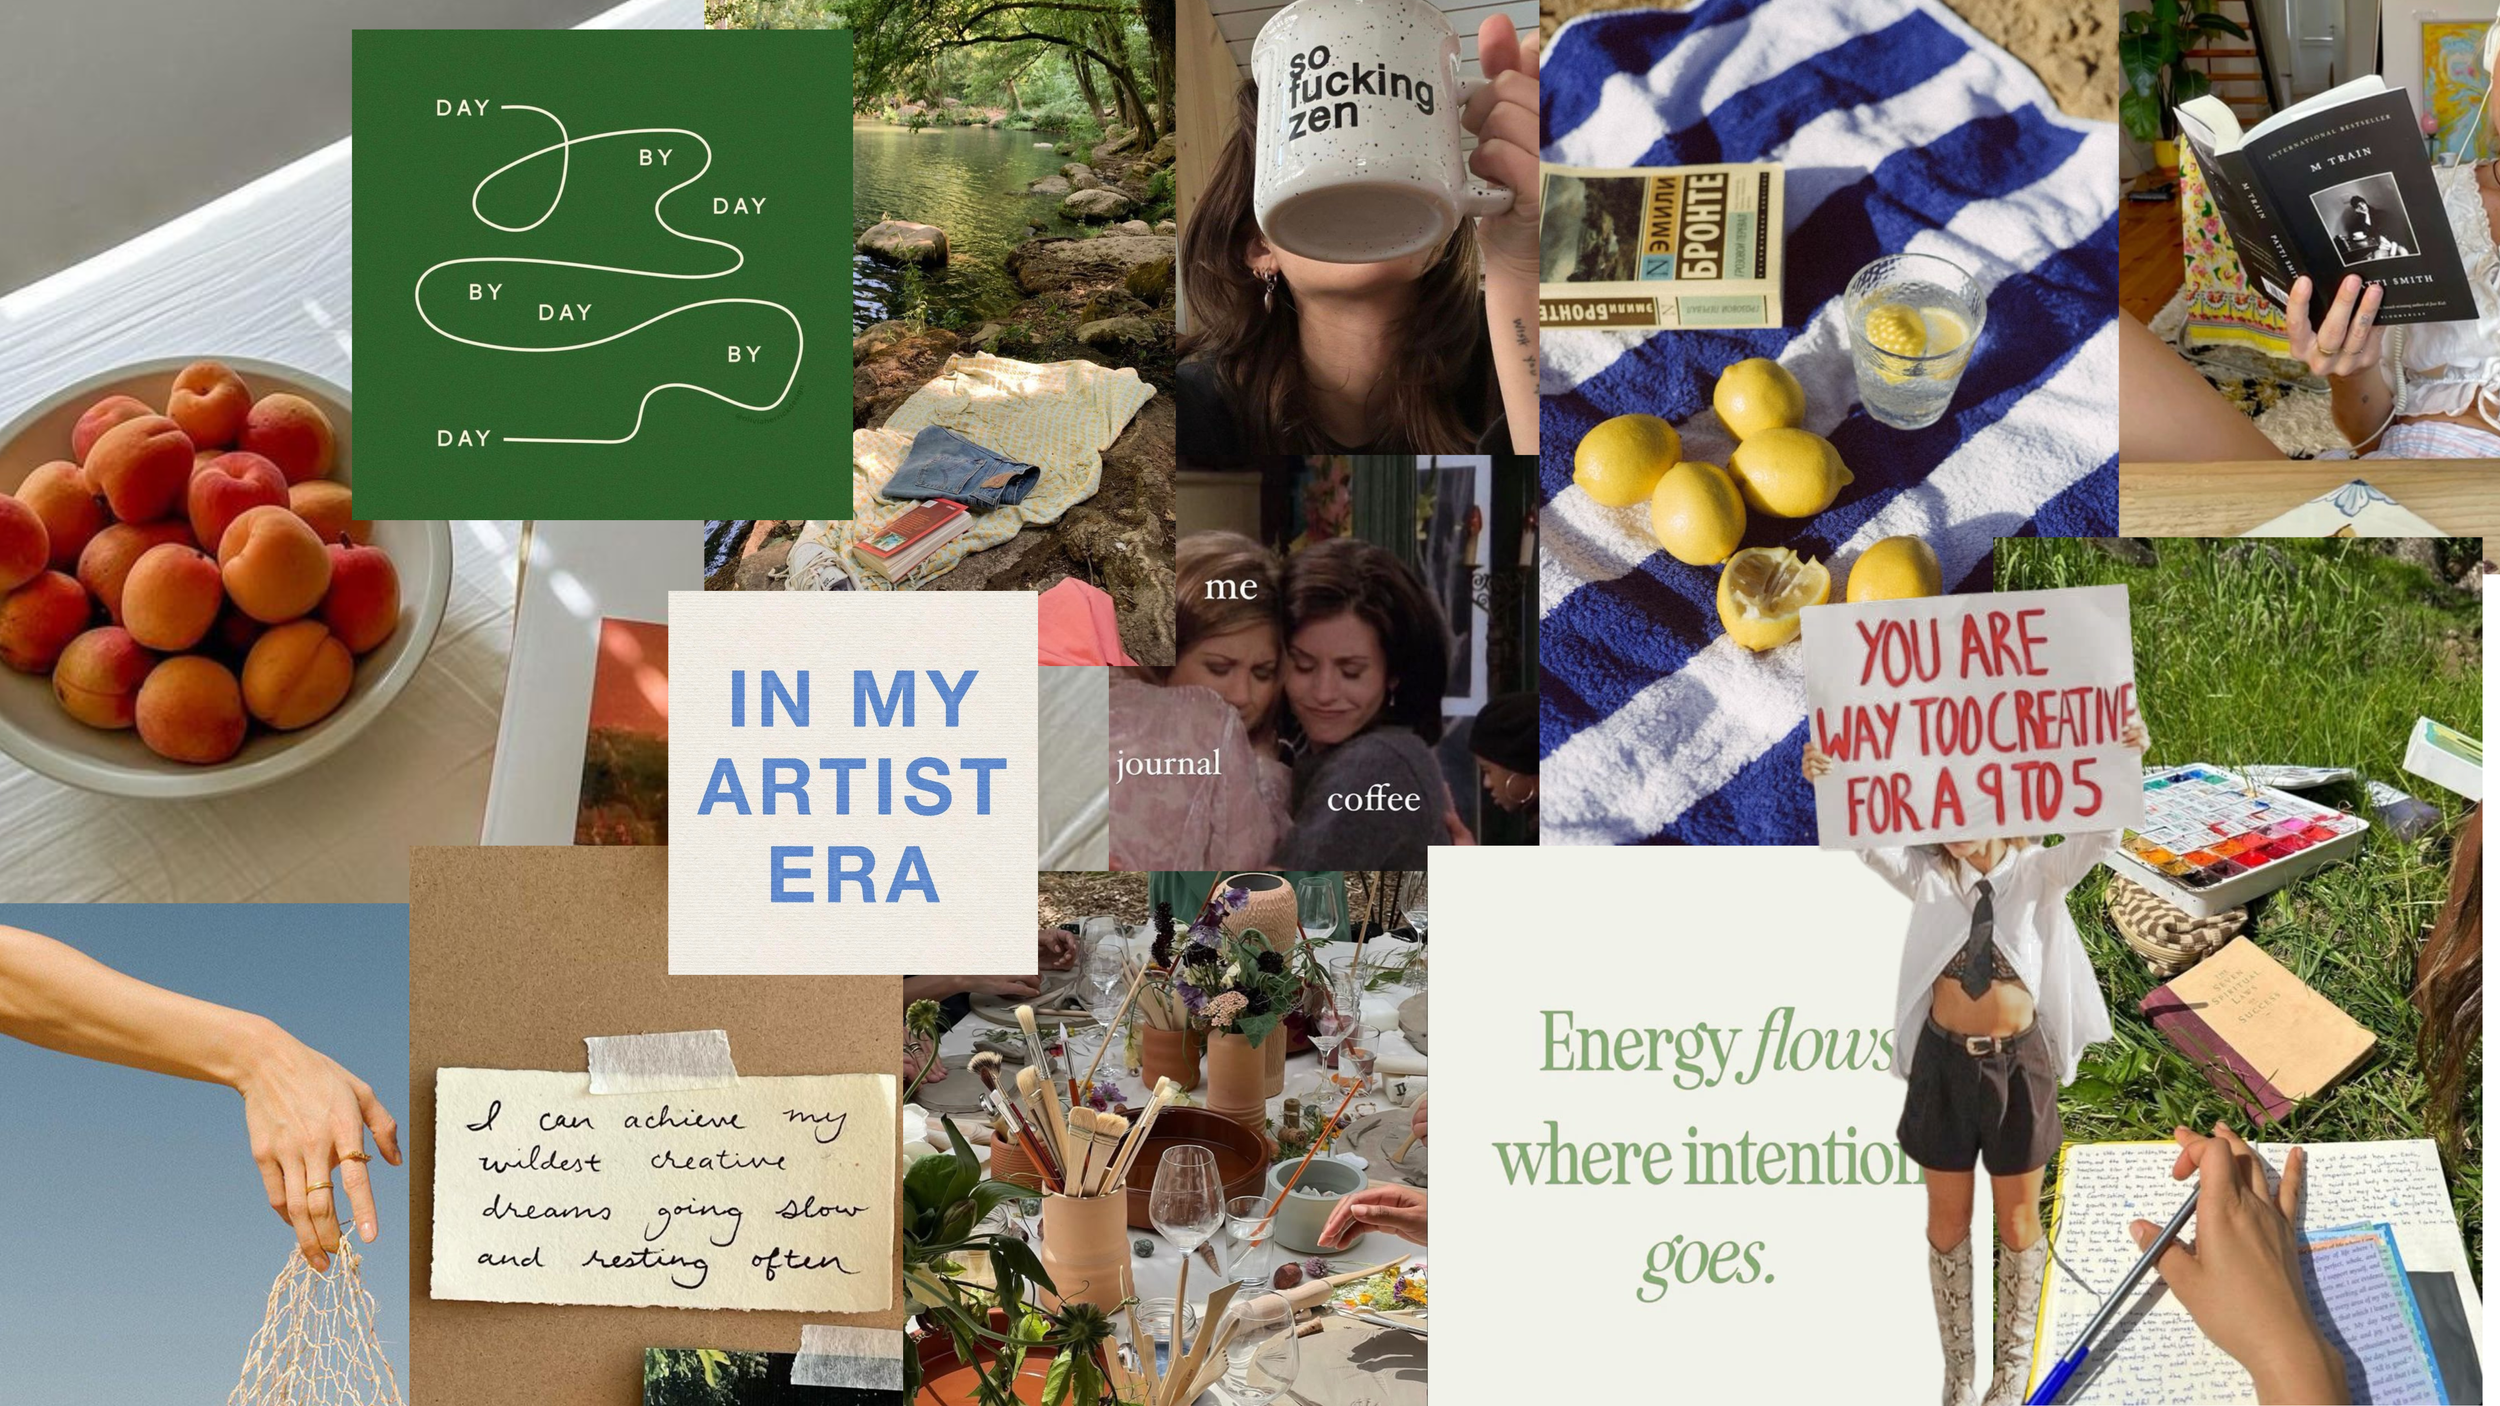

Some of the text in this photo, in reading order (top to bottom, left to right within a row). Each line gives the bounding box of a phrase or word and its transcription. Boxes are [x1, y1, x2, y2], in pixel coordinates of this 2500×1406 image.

[1290, 45, 1331, 78] so
[437, 99, 489, 117] DAY
[1289, 62, 1435, 116] fucking
[1289, 101, 1359, 142] zen
[2267, 114, 2392, 161] INTERNATIONAL BESTSELLER
[639, 148, 673, 166] BY
[2310, 147, 2372, 173] M TRAIN
[713, 197, 766, 215] DAY
[1649, 175, 1677, 252] ЭМИЛИ
[2242, 182, 2266, 219] M TRAIN
[1681, 173, 1725, 280] БРОНТЕ
[2270, 234, 2299, 279] PATTI SMIT
[469, 283, 502, 301] BY
[2393, 274, 2434, 286] SMITH
[538, 303, 592, 321] DAY
[728, 345, 761, 363] BY
[437, 429, 491, 447] DAY
[1856, 608, 2049, 688] YOU ARE
[731, 670, 980, 727] IN MY
[1816, 702, 1900, 763] WAY
[1910, 696, 1983, 756] TOO
[697, 756, 1008, 817] ARTIST
[1847, 773, 1925, 836] FOR
[1931, 766, 1965, 830] A
[1977, 762, 2005, 826] 9
[2011, 760, 2063, 822] TO
[2072, 757, 2103, 817] 5
[770, 845, 941, 903] ERA
[2211, 970, 2261, 1006] SPIRITUAL
[2237, 992, 2281, 1024] SUCCESS
[1539, 1006, 1896, 1091] Energy flows
[466, 1100, 847, 1144] I can achieve my
[478, 1145, 787, 1174] wildest creative
[1492, 1120, 1674, 1186] where
[483, 1194, 869, 1247] dreams going slow
[477, 1247, 861, 1290] and resting often
[1636, 1234, 1776, 1303] goes.
